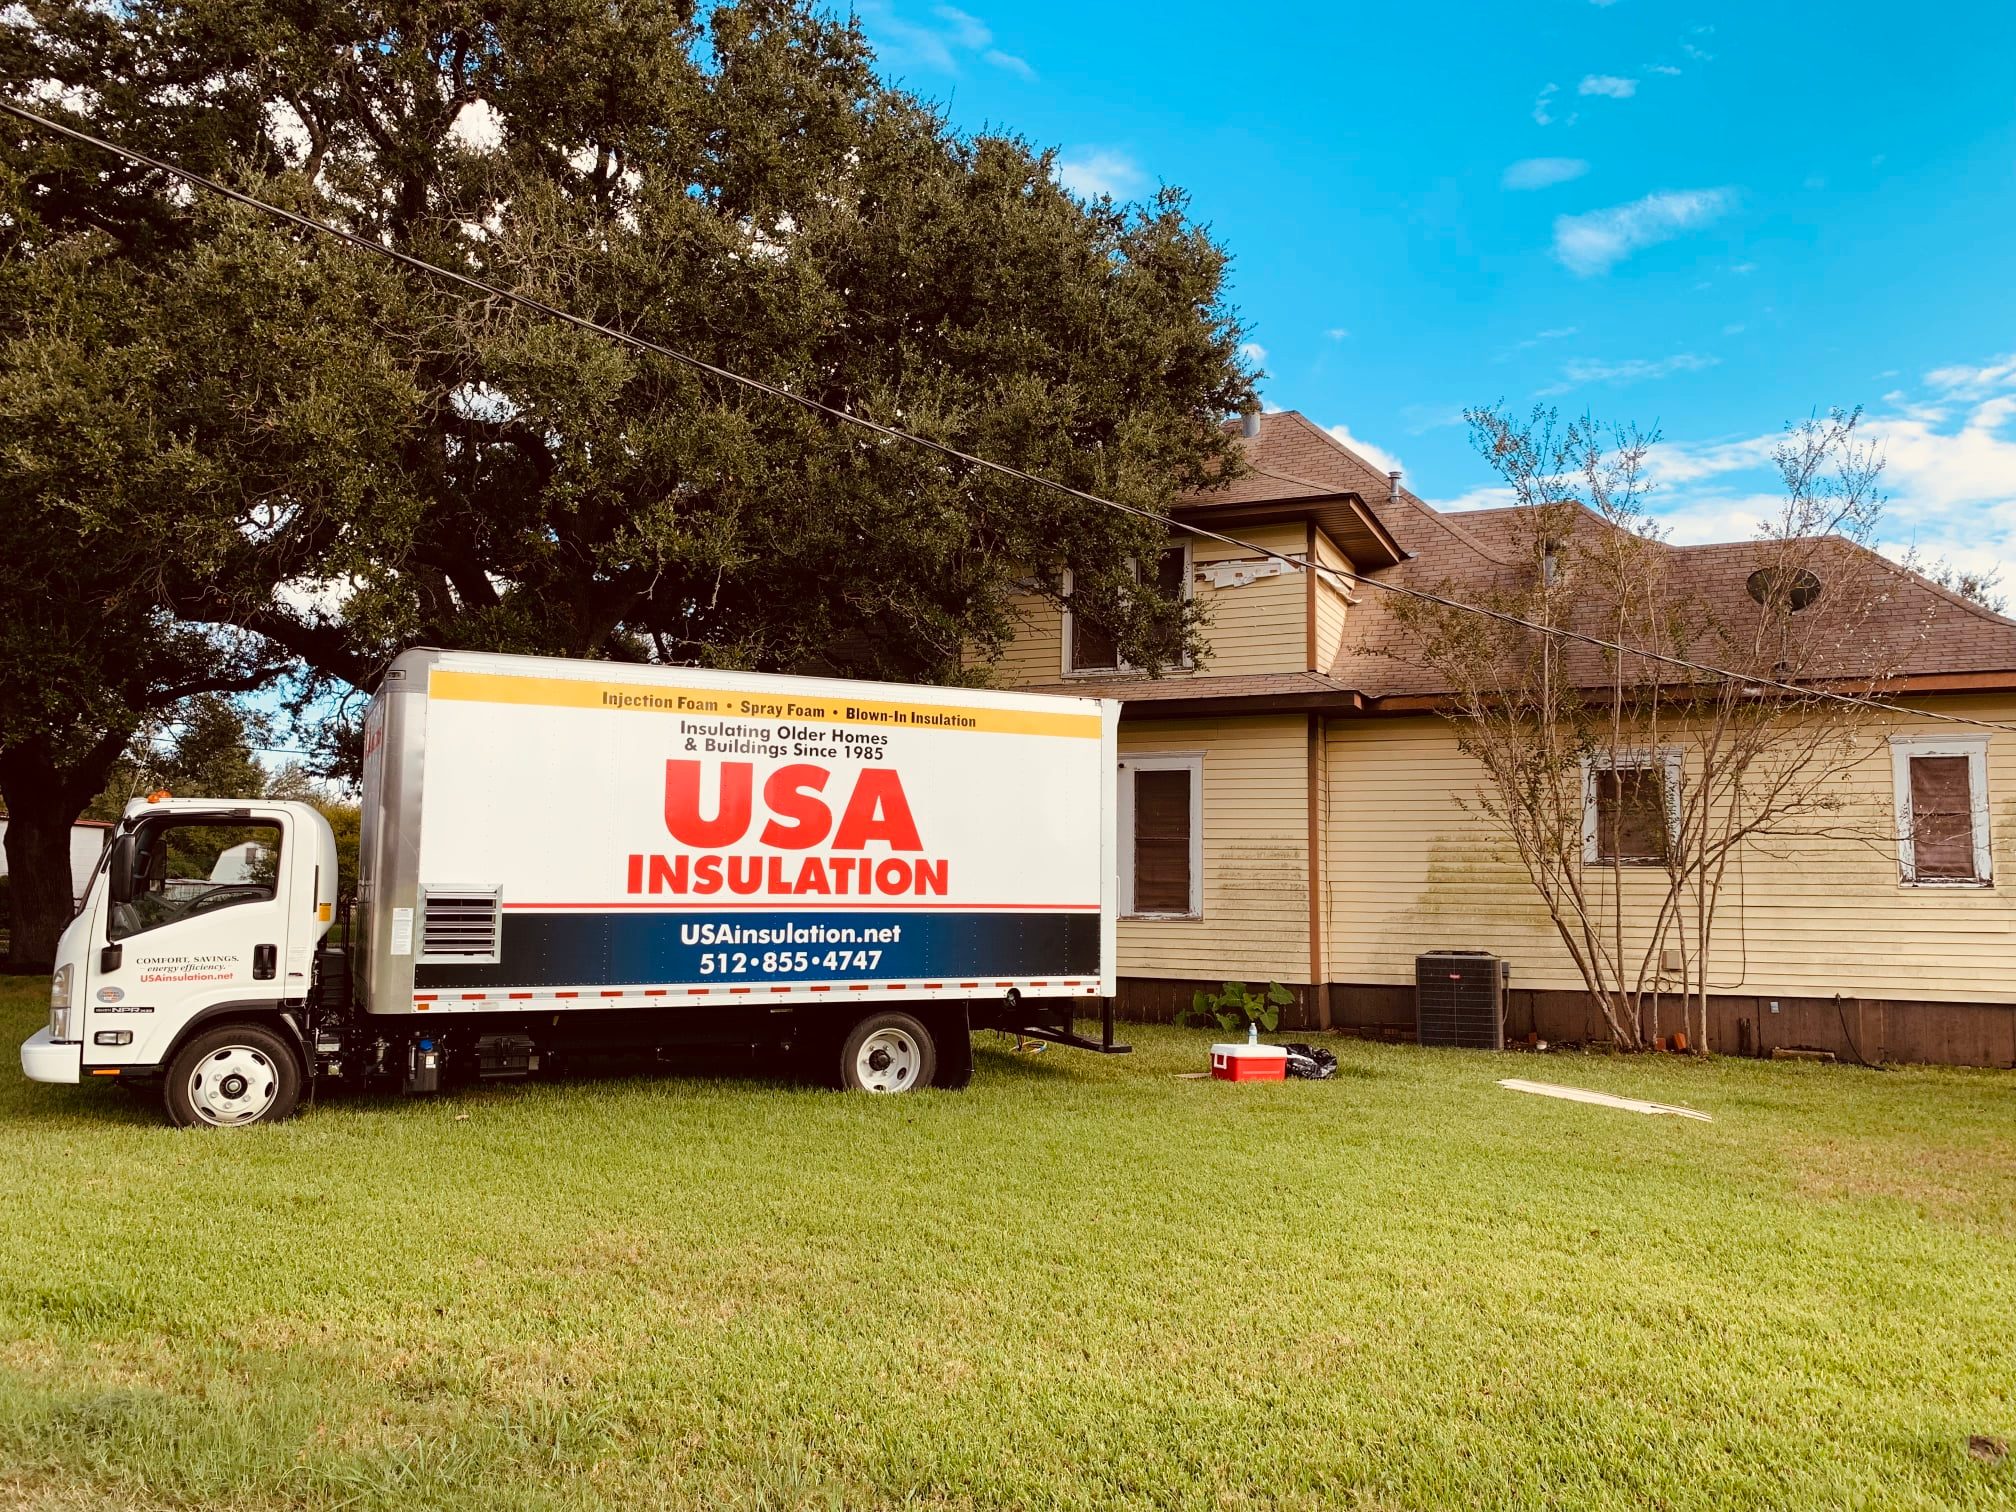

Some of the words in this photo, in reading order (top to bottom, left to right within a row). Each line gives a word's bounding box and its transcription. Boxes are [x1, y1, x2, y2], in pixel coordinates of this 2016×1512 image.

[602, 691, 673, 709] Injection
[677, 696, 718, 712] Foam
[740, 700, 783, 718] Spray
[787, 703, 825, 718] Foam
[846, 707, 907, 723] Blown-In
[911, 711, 977, 728] Insulation
[680, 720, 771, 742] Insulating
[777, 725, 826, 742] Older
[831, 728, 888, 745] Homes
[684, 737, 698, 752] &
[705, 738, 788, 758] Buildings
[793, 742, 838, 758] Since
[844, 745, 884, 761] 1985
[664, 758, 924, 852] USA
[627, 854, 949, 896] INSULATION
[680, 922, 901, 945] USAinsulation.net
[140, 972, 234, 983] USAinsulation.net
[147, 964, 179, 973] energy
